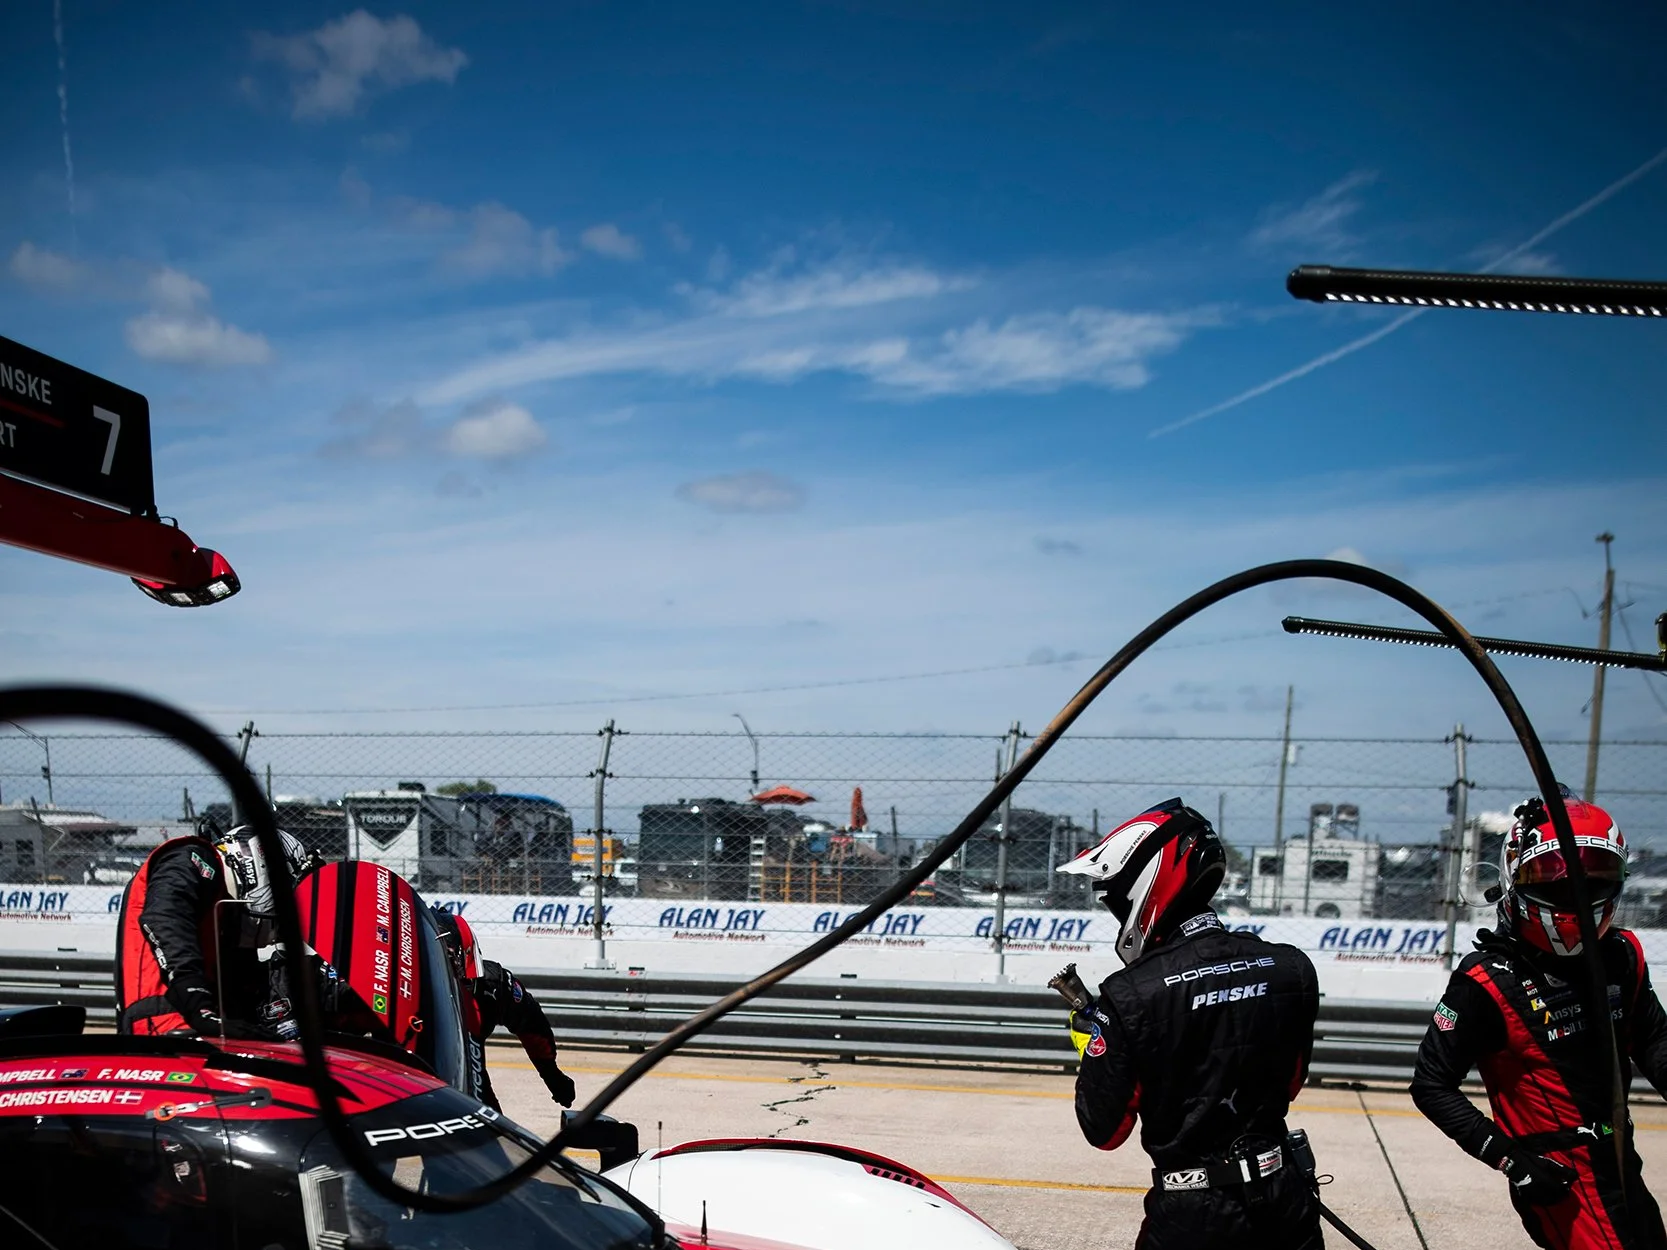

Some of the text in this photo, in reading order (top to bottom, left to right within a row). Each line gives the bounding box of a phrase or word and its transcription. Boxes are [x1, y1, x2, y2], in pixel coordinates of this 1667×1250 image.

[92, 404, 121, 476] 7
[360, 814, 407, 825] TORQUE
[376, 867, 389, 912] CAMPBELL
[36, 892, 69, 912] JAY
[40, 912, 71, 920] Network
[512, 903, 570, 923] ALAN
[659, 907, 766, 931] ALAN JAY
[526, 925, 613, 937] Automotive Netork
[880, 913, 925, 936] JAY
[975, 916, 1092, 942] AAN JAY
[400, 898, 412, 980] M. CHRISTENSEN
[672, 930, 767, 941] Automotive Network
[883, 938, 925, 947] Network
[1319, 927, 1447, 953] ALAN JAY
[1047, 942, 1091, 952] Network
[374, 949, 389, 982] NASR
[1335, 953, 1396, 963] Automotive
[1163, 957, 1276, 987] PORSCHE
[373, 983, 388, 994] F.
[1191, 982, 1268, 1010] PENSKE
[1437, 1003, 1456, 1021] TAG
[1543, 1003, 1582, 1025] Ansys
[1547, 1021, 1577, 1042] Mobil
[97, 1068, 112, 1080] F.
[114, 1070, 165, 1082] NASR
[0, 1090, 114, 1108] CHRISTENSEN
